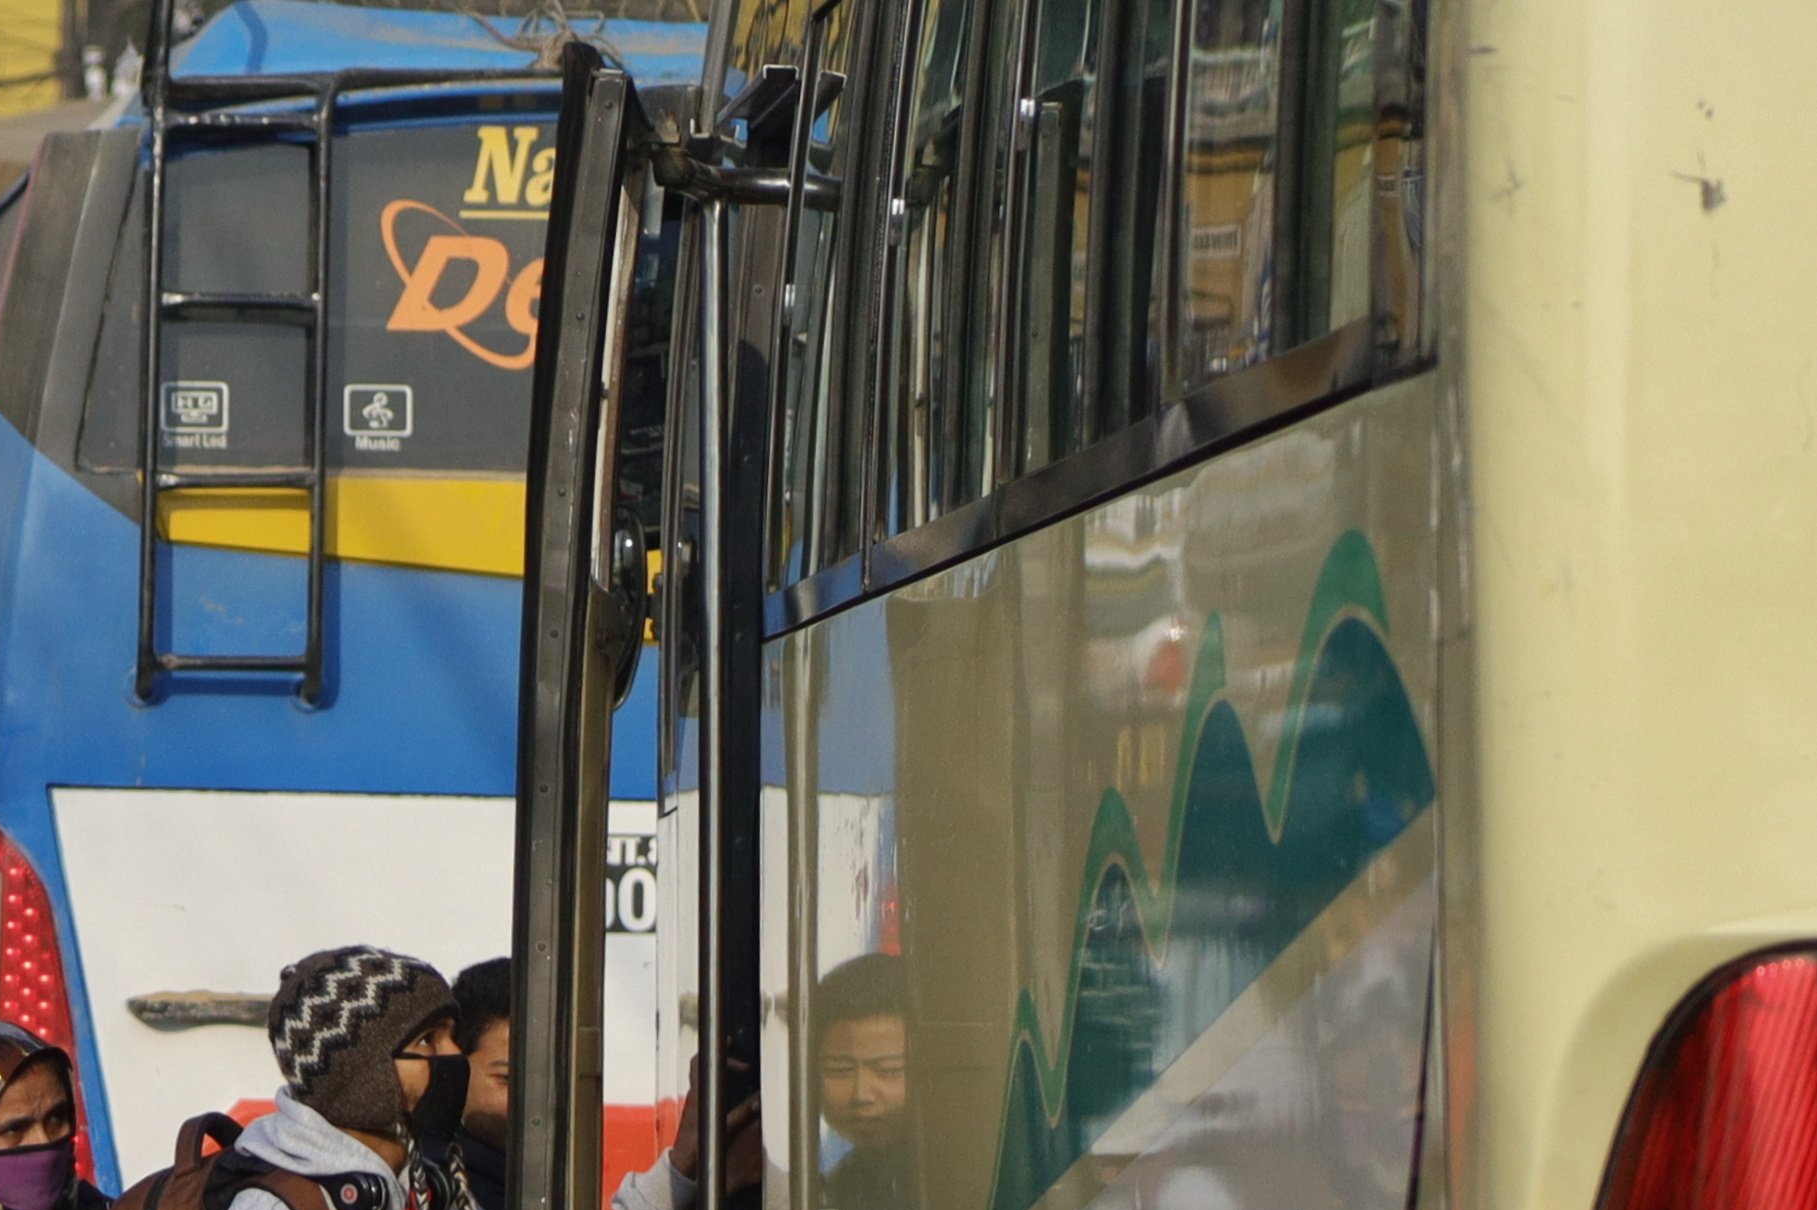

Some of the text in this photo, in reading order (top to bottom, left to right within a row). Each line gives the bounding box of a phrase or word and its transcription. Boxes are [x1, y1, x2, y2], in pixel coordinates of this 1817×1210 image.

[163, 433, 228, 450] Smart Led
[354, 435, 401, 451] Music
